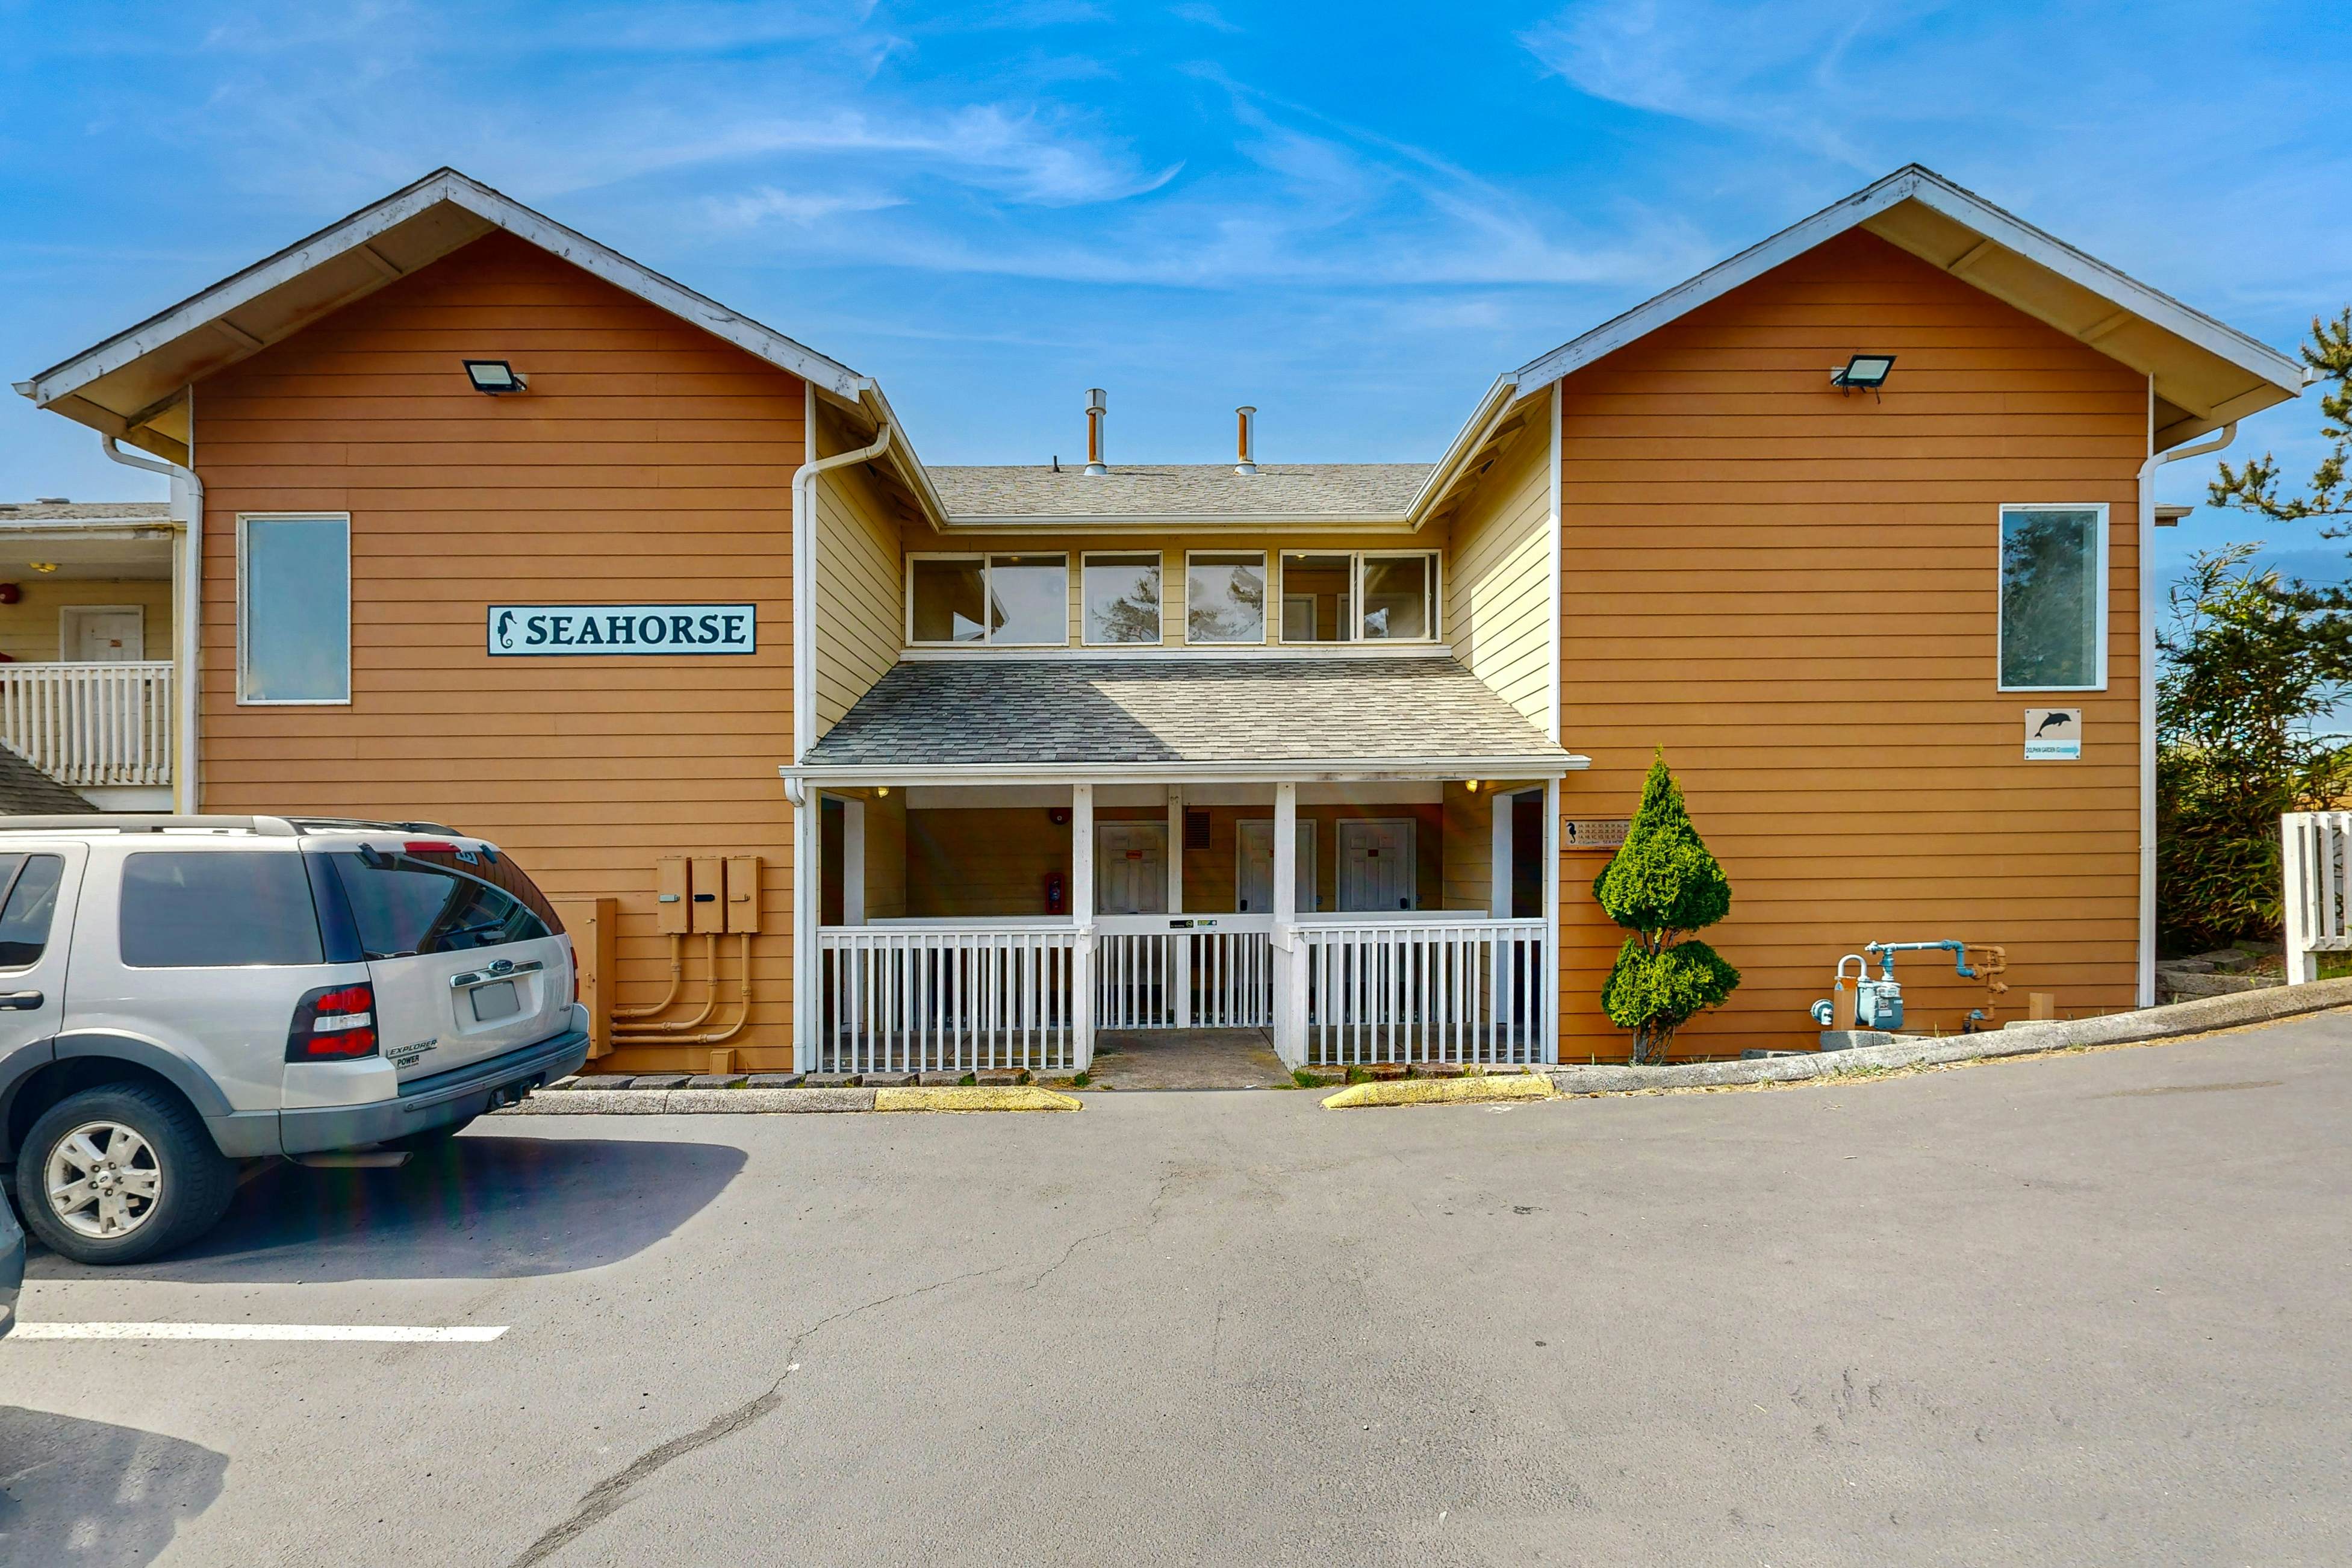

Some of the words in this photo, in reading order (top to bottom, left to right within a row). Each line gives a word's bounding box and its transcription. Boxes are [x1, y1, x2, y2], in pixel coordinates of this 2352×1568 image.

[526, 614, 746, 645] SEAHORSE
[390, 1039, 437, 1055] EXPLORER
[397, 1055, 420, 1066] POWER
